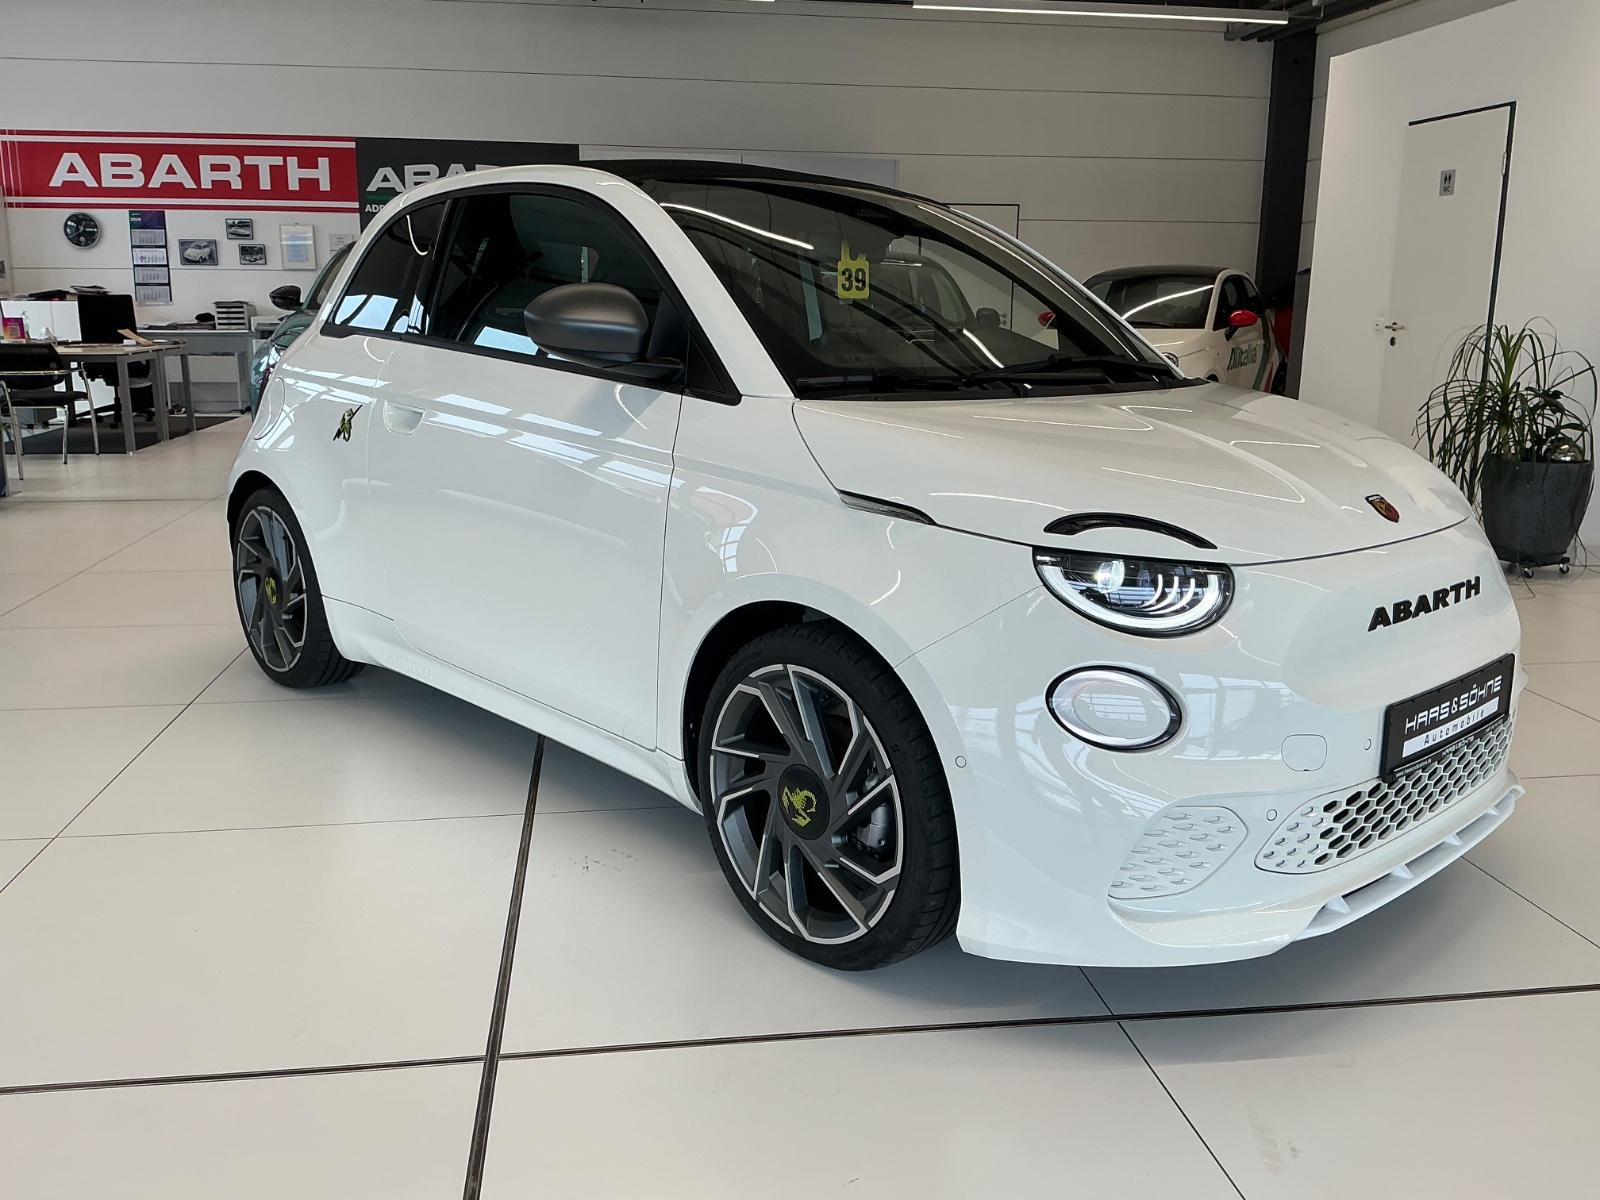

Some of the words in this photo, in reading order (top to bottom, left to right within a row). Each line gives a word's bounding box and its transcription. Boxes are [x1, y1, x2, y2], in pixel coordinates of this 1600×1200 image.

[48, 152, 331, 191] ABARTH
[841, 267, 867, 292] 39
[1226, 344, 1258, 371] Alitalia
[1367, 576, 1481, 632] ABARTH
[1423, 709, 1485, 747] Automobile
